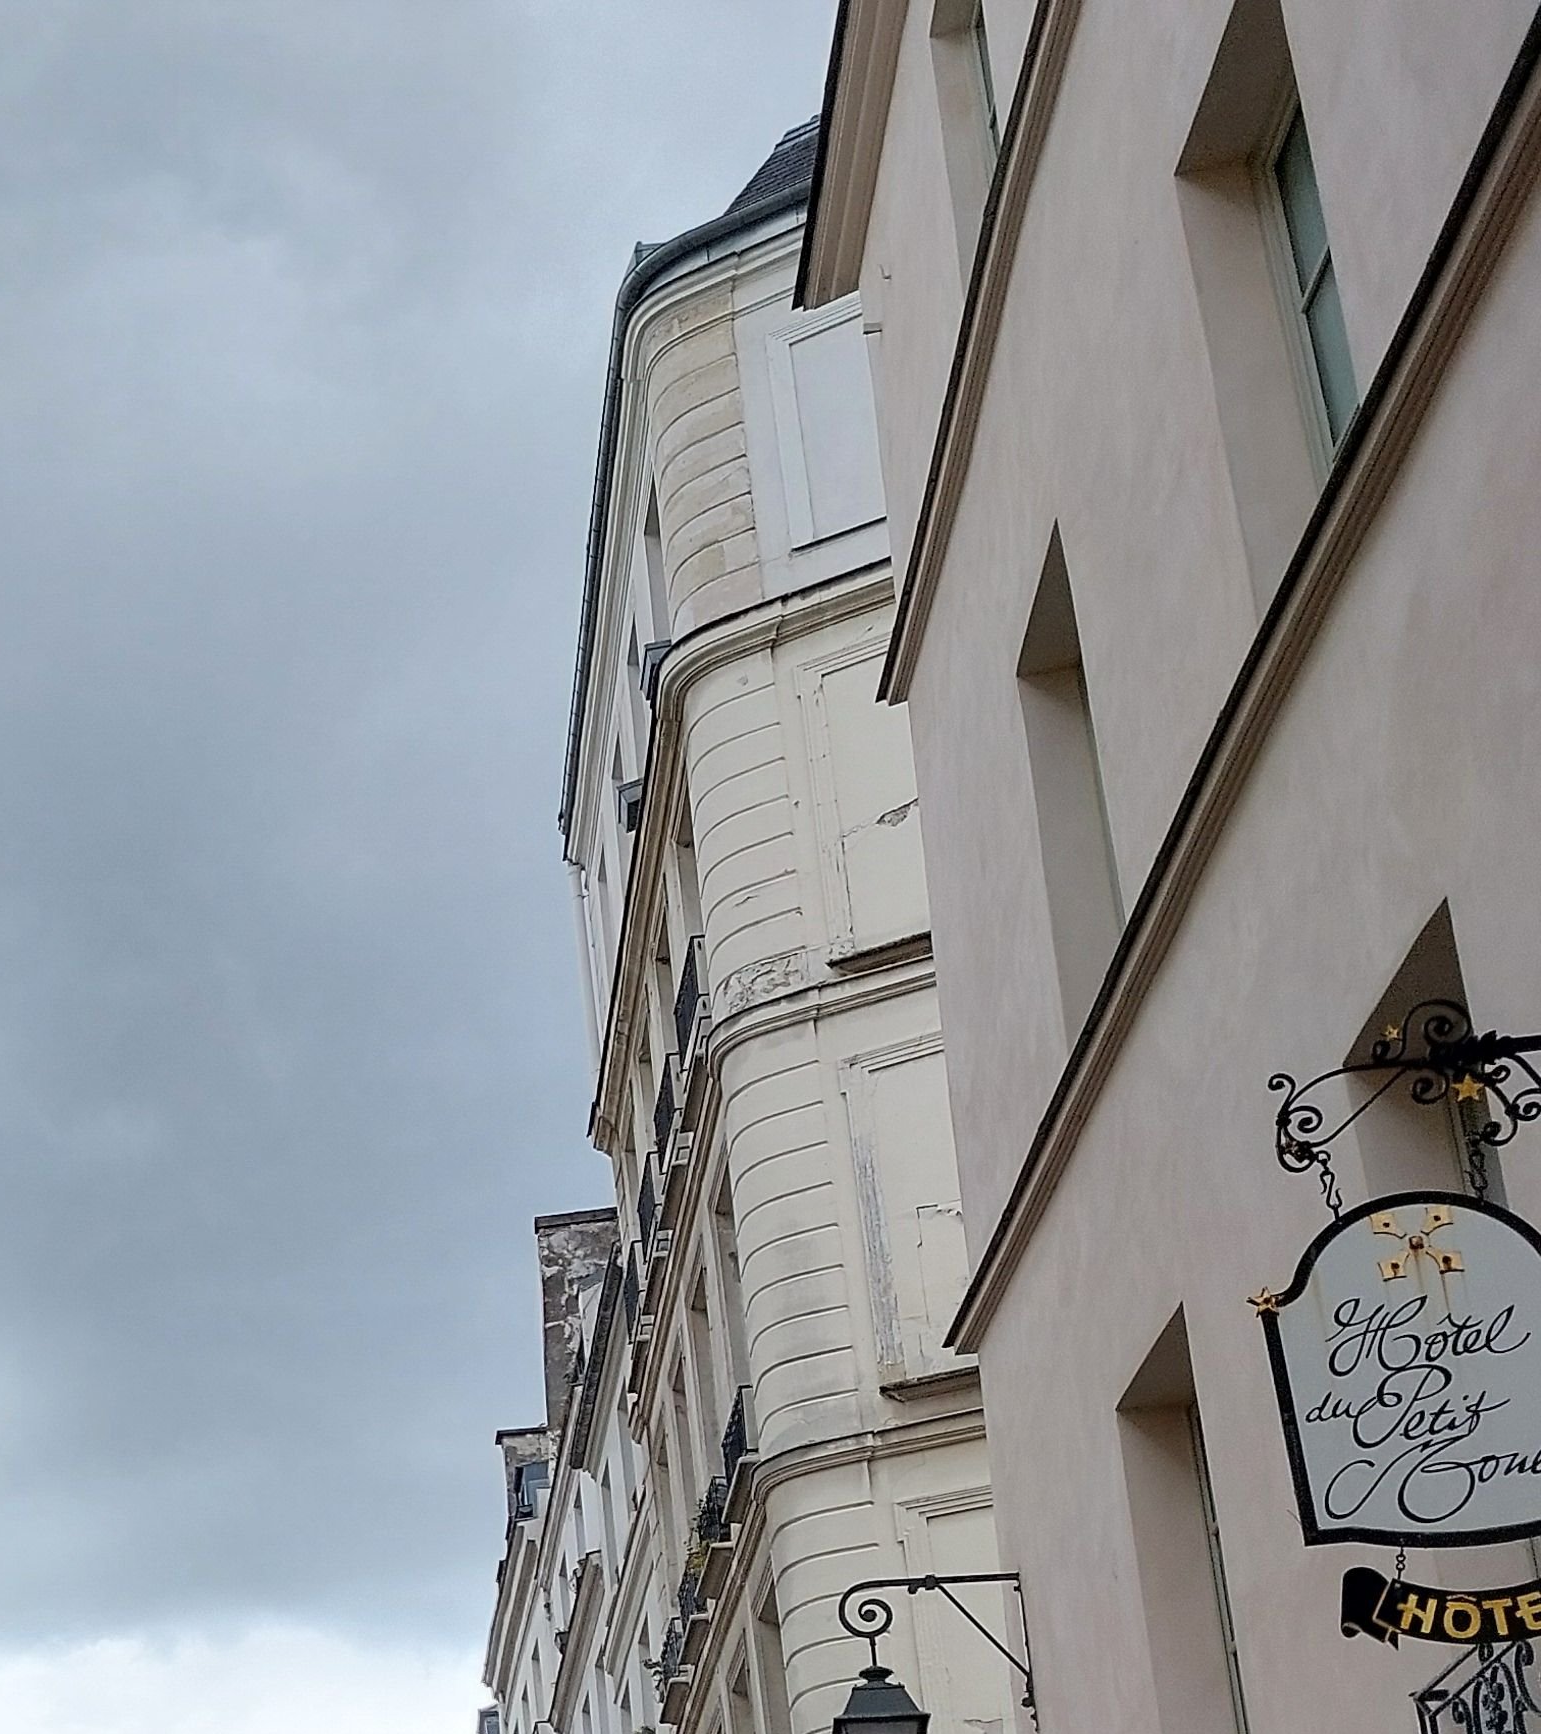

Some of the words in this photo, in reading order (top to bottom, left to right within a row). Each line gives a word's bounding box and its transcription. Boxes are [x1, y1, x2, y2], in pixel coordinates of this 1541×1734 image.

[1325, 1293, 1531, 1377] Hôtel
[1305, 1391, 1356, 1424] du
[1353, 1364, 1511, 1449] Petit
